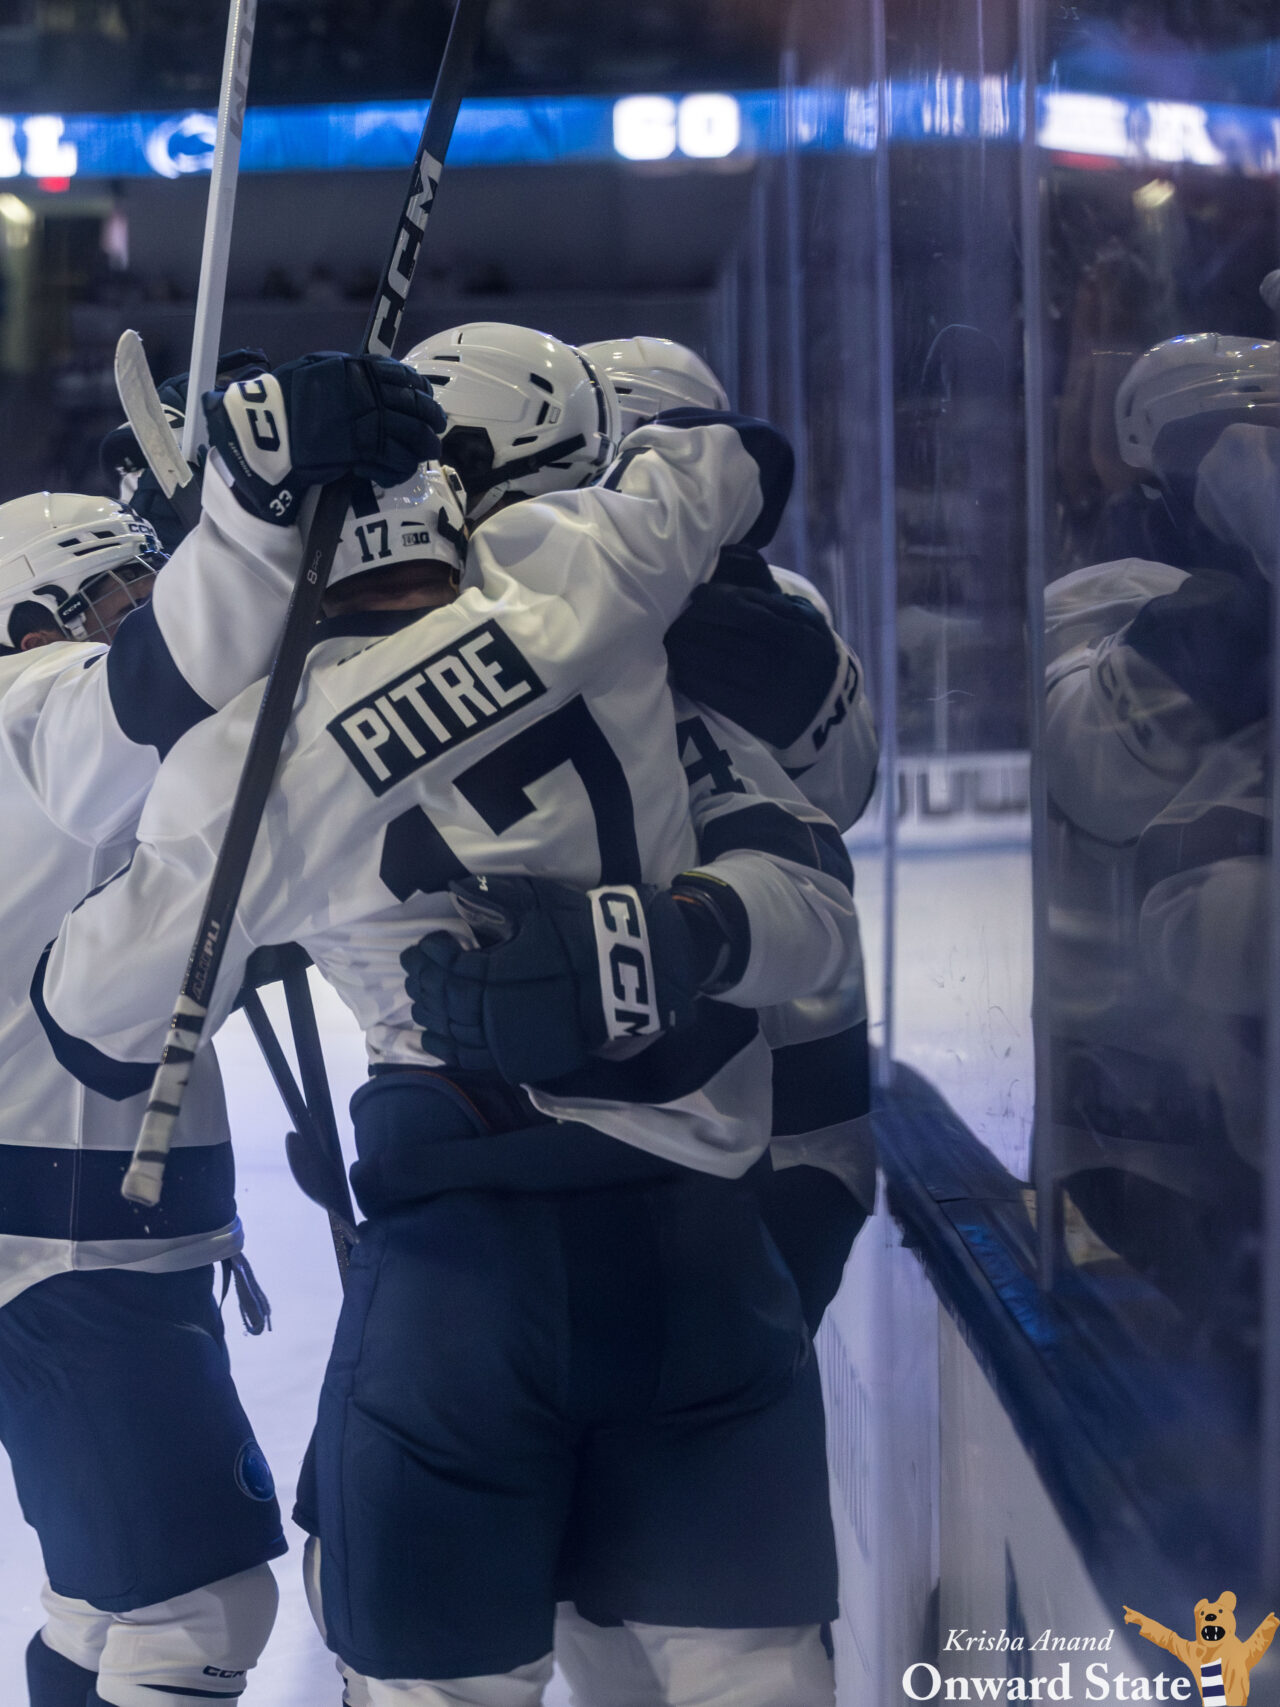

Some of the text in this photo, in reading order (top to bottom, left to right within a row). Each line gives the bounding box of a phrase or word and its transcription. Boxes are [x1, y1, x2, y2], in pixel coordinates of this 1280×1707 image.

[368, 150, 444, 359] CCM
[269, 489, 293, 516] 33
[354, 518, 393, 563] 17
[340, 630, 532, 782] PITRE
[598, 891, 651, 1036] CCM
